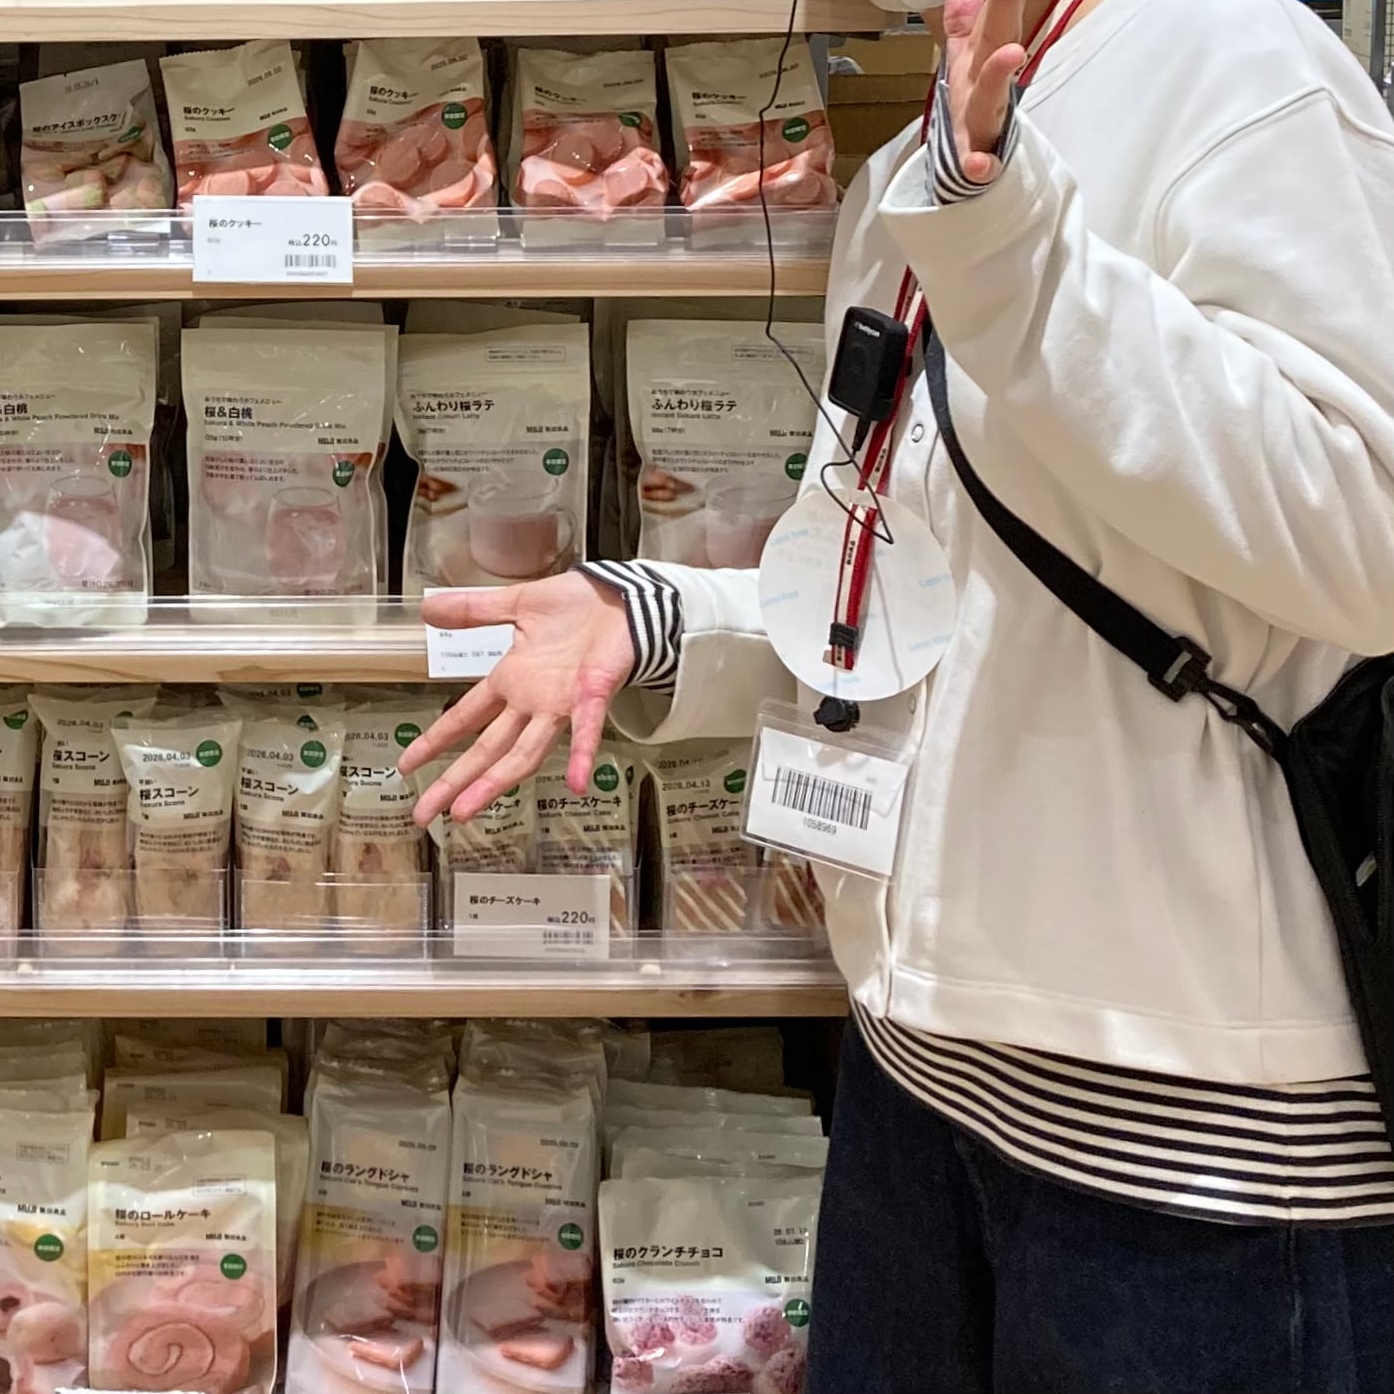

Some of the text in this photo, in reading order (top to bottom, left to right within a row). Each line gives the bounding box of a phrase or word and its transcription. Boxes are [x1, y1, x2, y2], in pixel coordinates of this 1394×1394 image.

[208, 218, 262, 228] 桜のクッキー
[412, 400, 495, 412] ふんわり桜ラテ
[651, 398, 737, 412] ふんわり桜ラテ
[204, 407, 253, 419] 桜&白桃
[53, 749, 110, 763] 桜スコーン
[240, 776, 299, 796] 桜スコーン
[139, 786, 199, 801] 桜スコーン
[537, 796, 622, 810] 桜のチーズケーキ
[469, 895, 541, 906] 桜のチーズケーキ
[321, 1161, 410, 1182] 桜のラングドシャ
[463, 1162, 553, 1182] 桜のラングドシャ
[115, 1208, 211, 1222] 桜のロールケーキ
[613, 1246, 724, 1261] 桜のクランチチョコ
